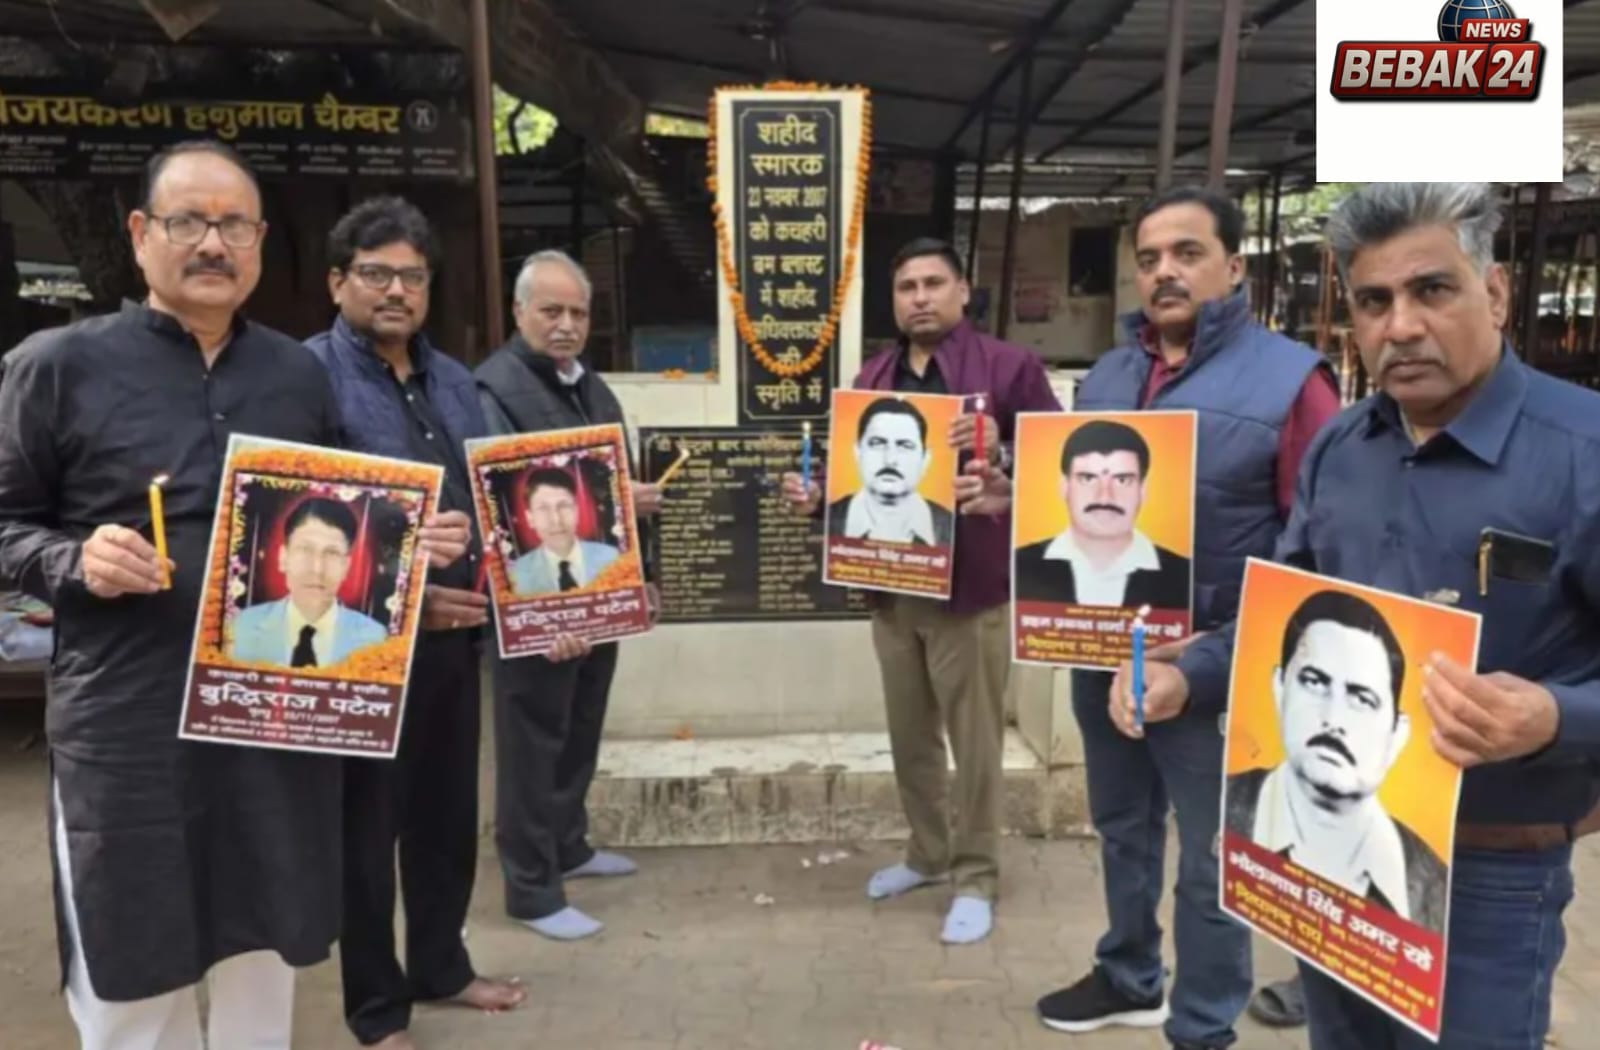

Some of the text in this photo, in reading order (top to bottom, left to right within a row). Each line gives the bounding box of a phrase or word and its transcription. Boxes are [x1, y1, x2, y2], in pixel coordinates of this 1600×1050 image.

[0, 92, 400, 139] जयकरण हनुमान चैम्बर
[757, 114, 817, 144] शहीद
[751, 154, 824, 176] स्मारक
[748, 213, 827, 242] को कचहरी
[752, 255, 775, 275] बम
[759, 281, 817, 309] में शहीद
[756, 377, 822, 410] स्मृति में
[199, 682, 393, 718] बुद्धिराज पटेल
